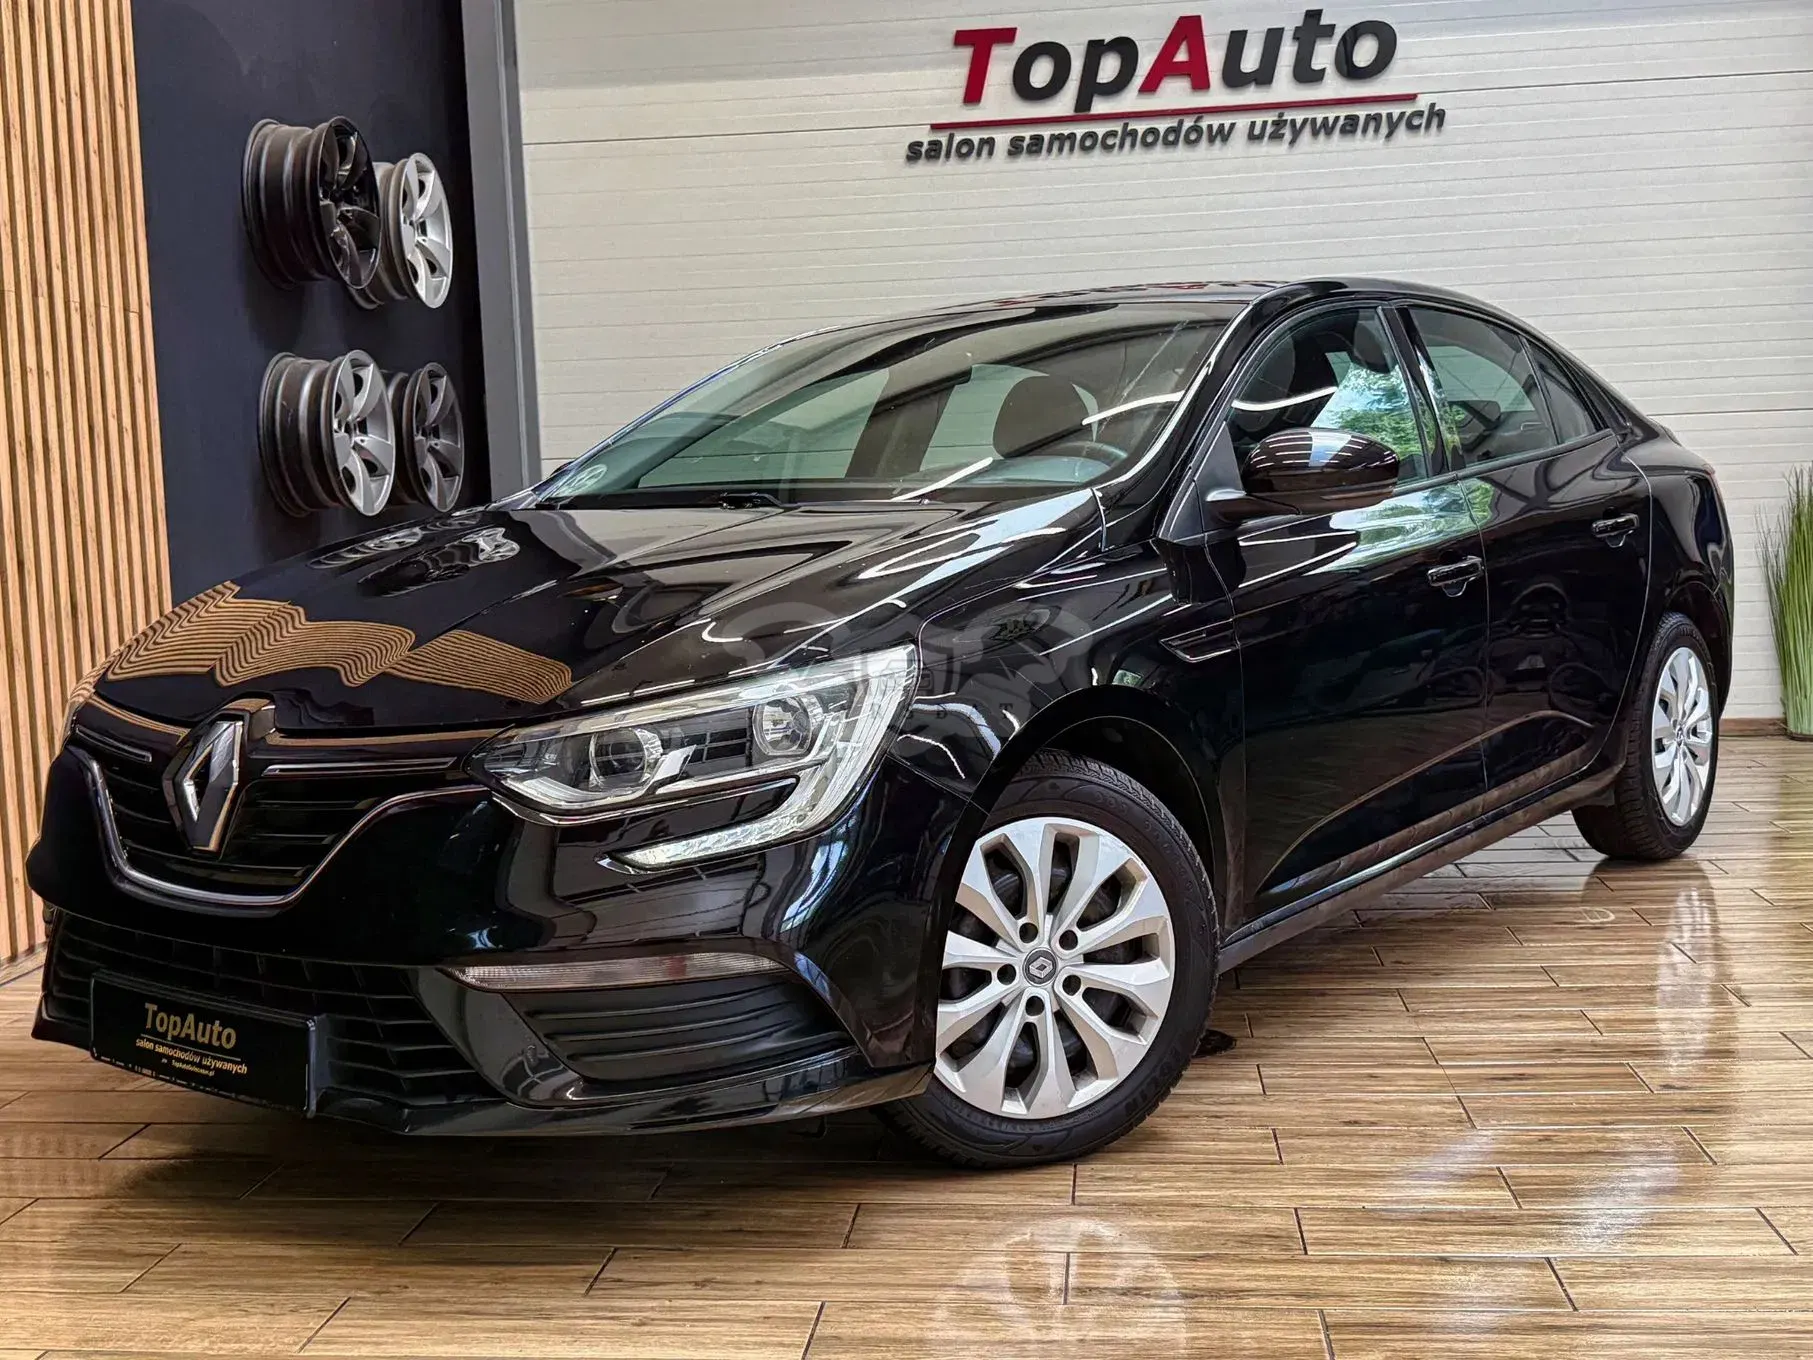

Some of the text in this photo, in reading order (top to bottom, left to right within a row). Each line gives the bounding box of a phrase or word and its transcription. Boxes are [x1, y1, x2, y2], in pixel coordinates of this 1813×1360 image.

[953, 8, 1398, 113] TopAuto
[905, 103, 1447, 163] salon samochodów używanych
[144, 1002, 237, 1049] TopAuto
[135, 1037, 154, 1051] salon
[155, 1043, 201, 1064] samochodów
[202, 1056, 248, 1075] używanych
